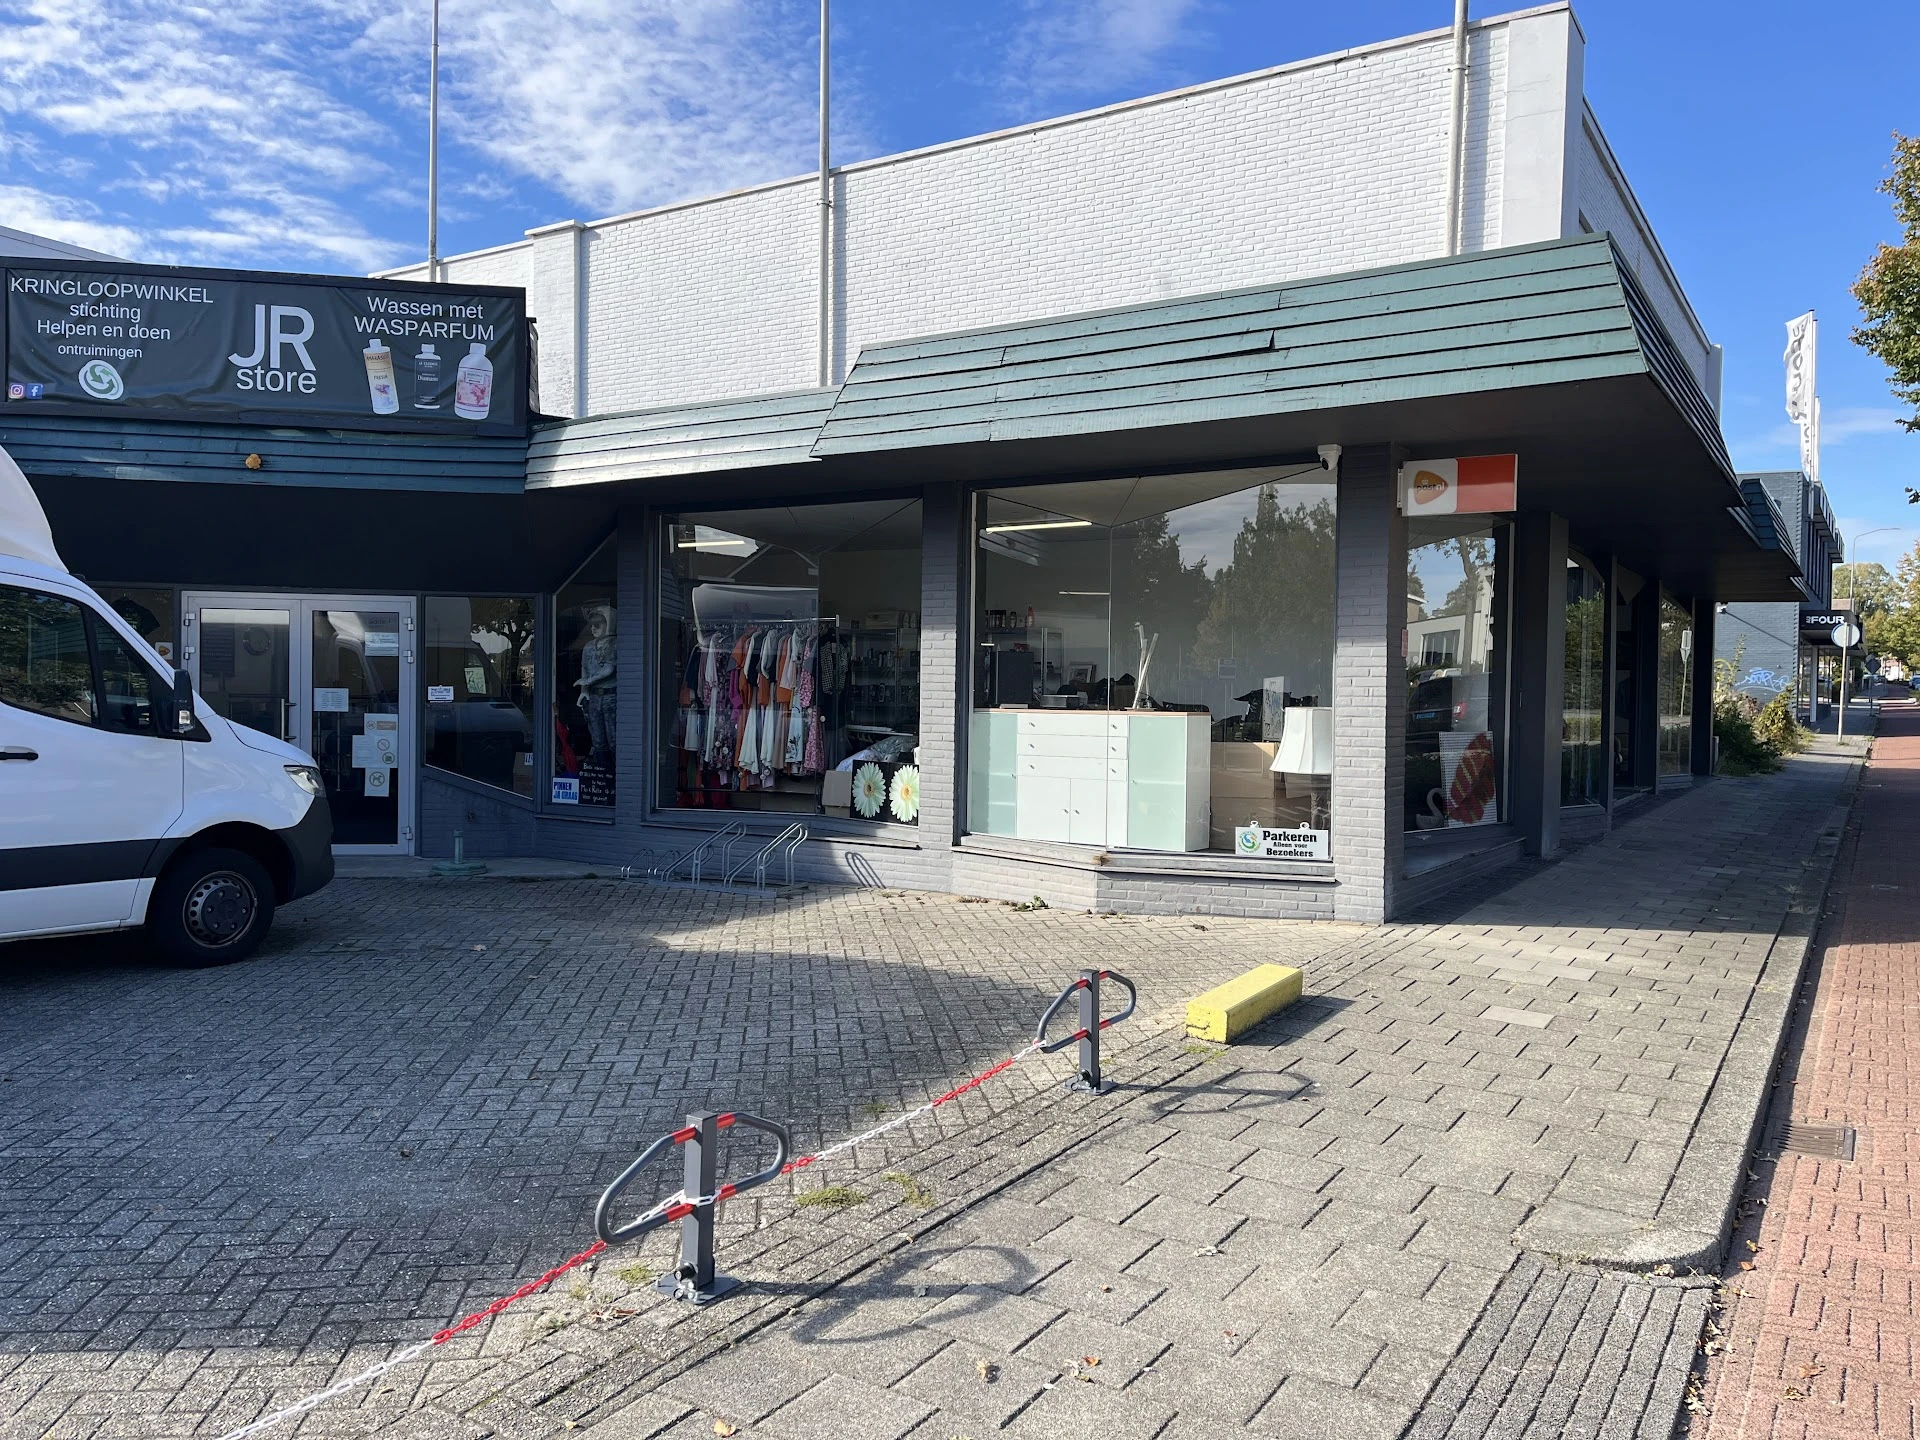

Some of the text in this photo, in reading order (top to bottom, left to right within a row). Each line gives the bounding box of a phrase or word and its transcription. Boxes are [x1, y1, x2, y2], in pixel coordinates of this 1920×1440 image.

[10, 277, 214, 304] KRINGLOOPWINKEL
[69, 302, 141, 323] stichting
[367, 296, 484, 320] Wassen met
[37, 320, 171, 340] Helpen en doen
[228, 304, 317, 371] JR
[353, 316, 494, 341] WASPARFUM
[58, 344, 143, 360] ontruimingen
[236, 365, 317, 394] store
[1811, 615, 1845, 625] FOUR
[1262, 830, 1317, 842] Parkeren
[1266, 848, 1313, 857] Bezoekers
